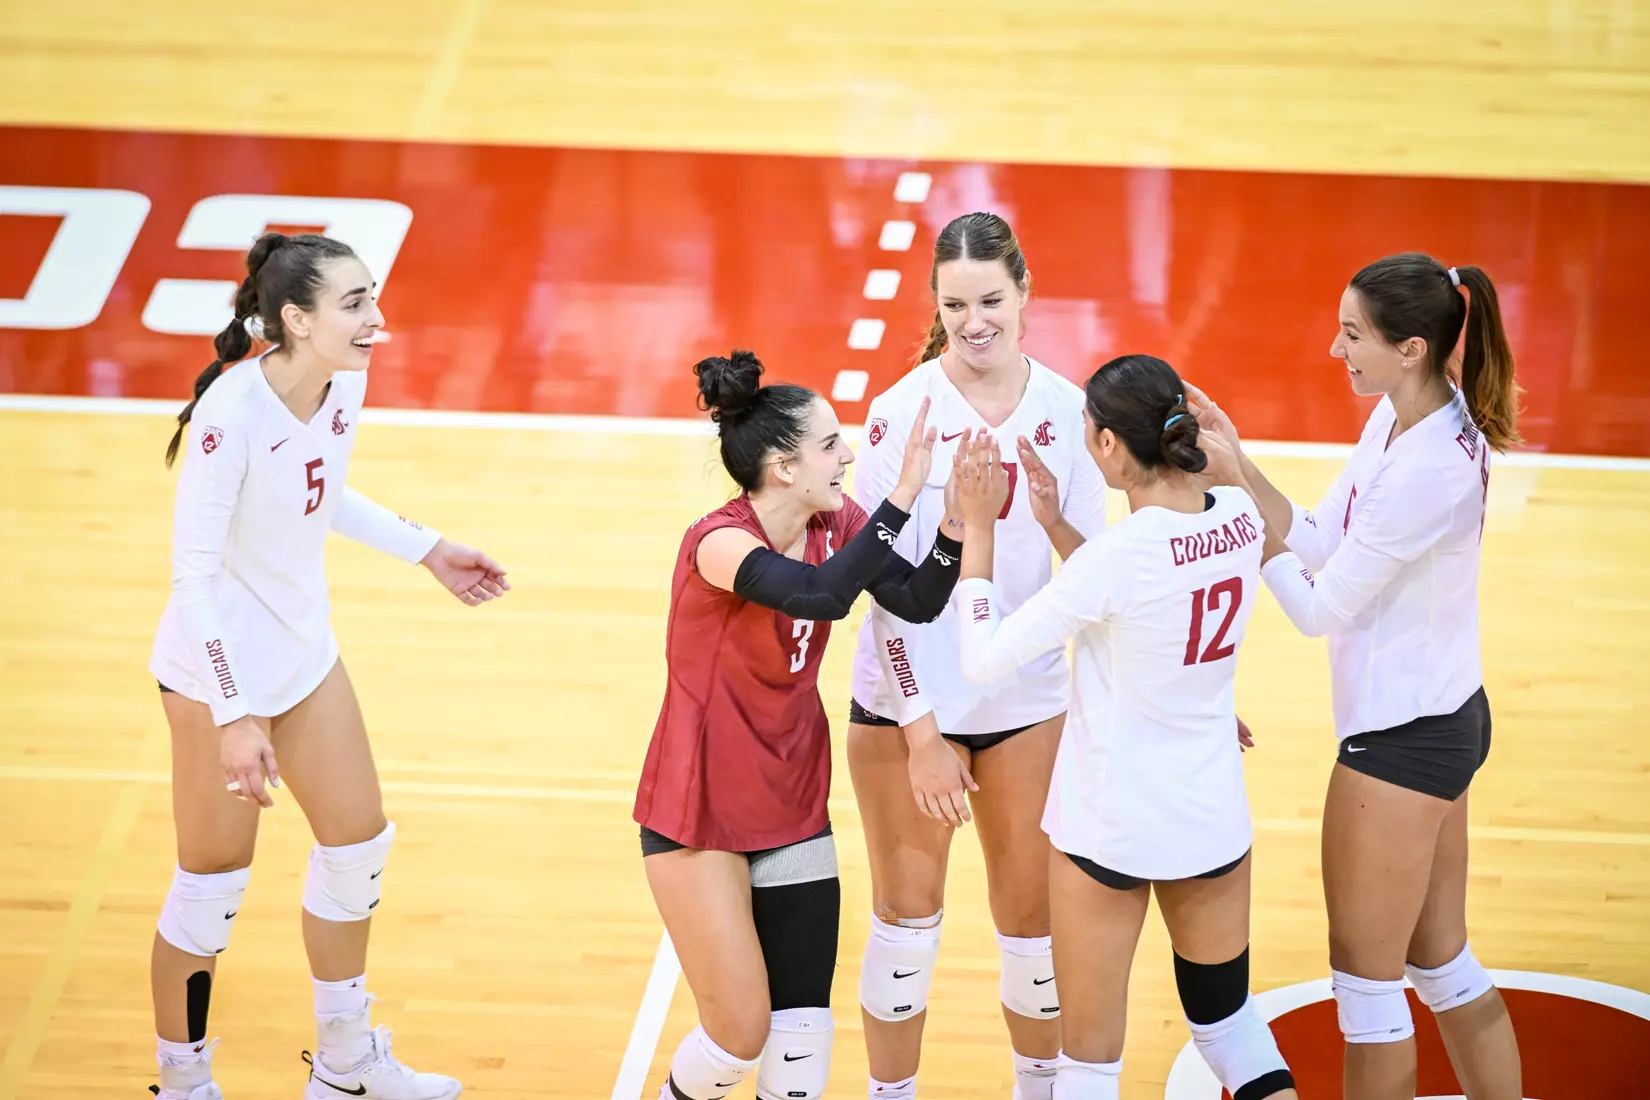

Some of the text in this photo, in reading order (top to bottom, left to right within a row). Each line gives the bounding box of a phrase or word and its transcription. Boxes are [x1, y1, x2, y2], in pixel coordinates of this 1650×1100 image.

[871, 432, 880, 442] 12
[304, 457, 324, 516] 5
[1170, 512, 1258, 566] COUGARS
[972, 597, 991, 628] WSU
[1183, 576, 1243, 666] 12
[206, 639, 238, 699] COUGARS
[790, 618, 814, 674] 3
[886, 637, 920, 698] COUGARS
